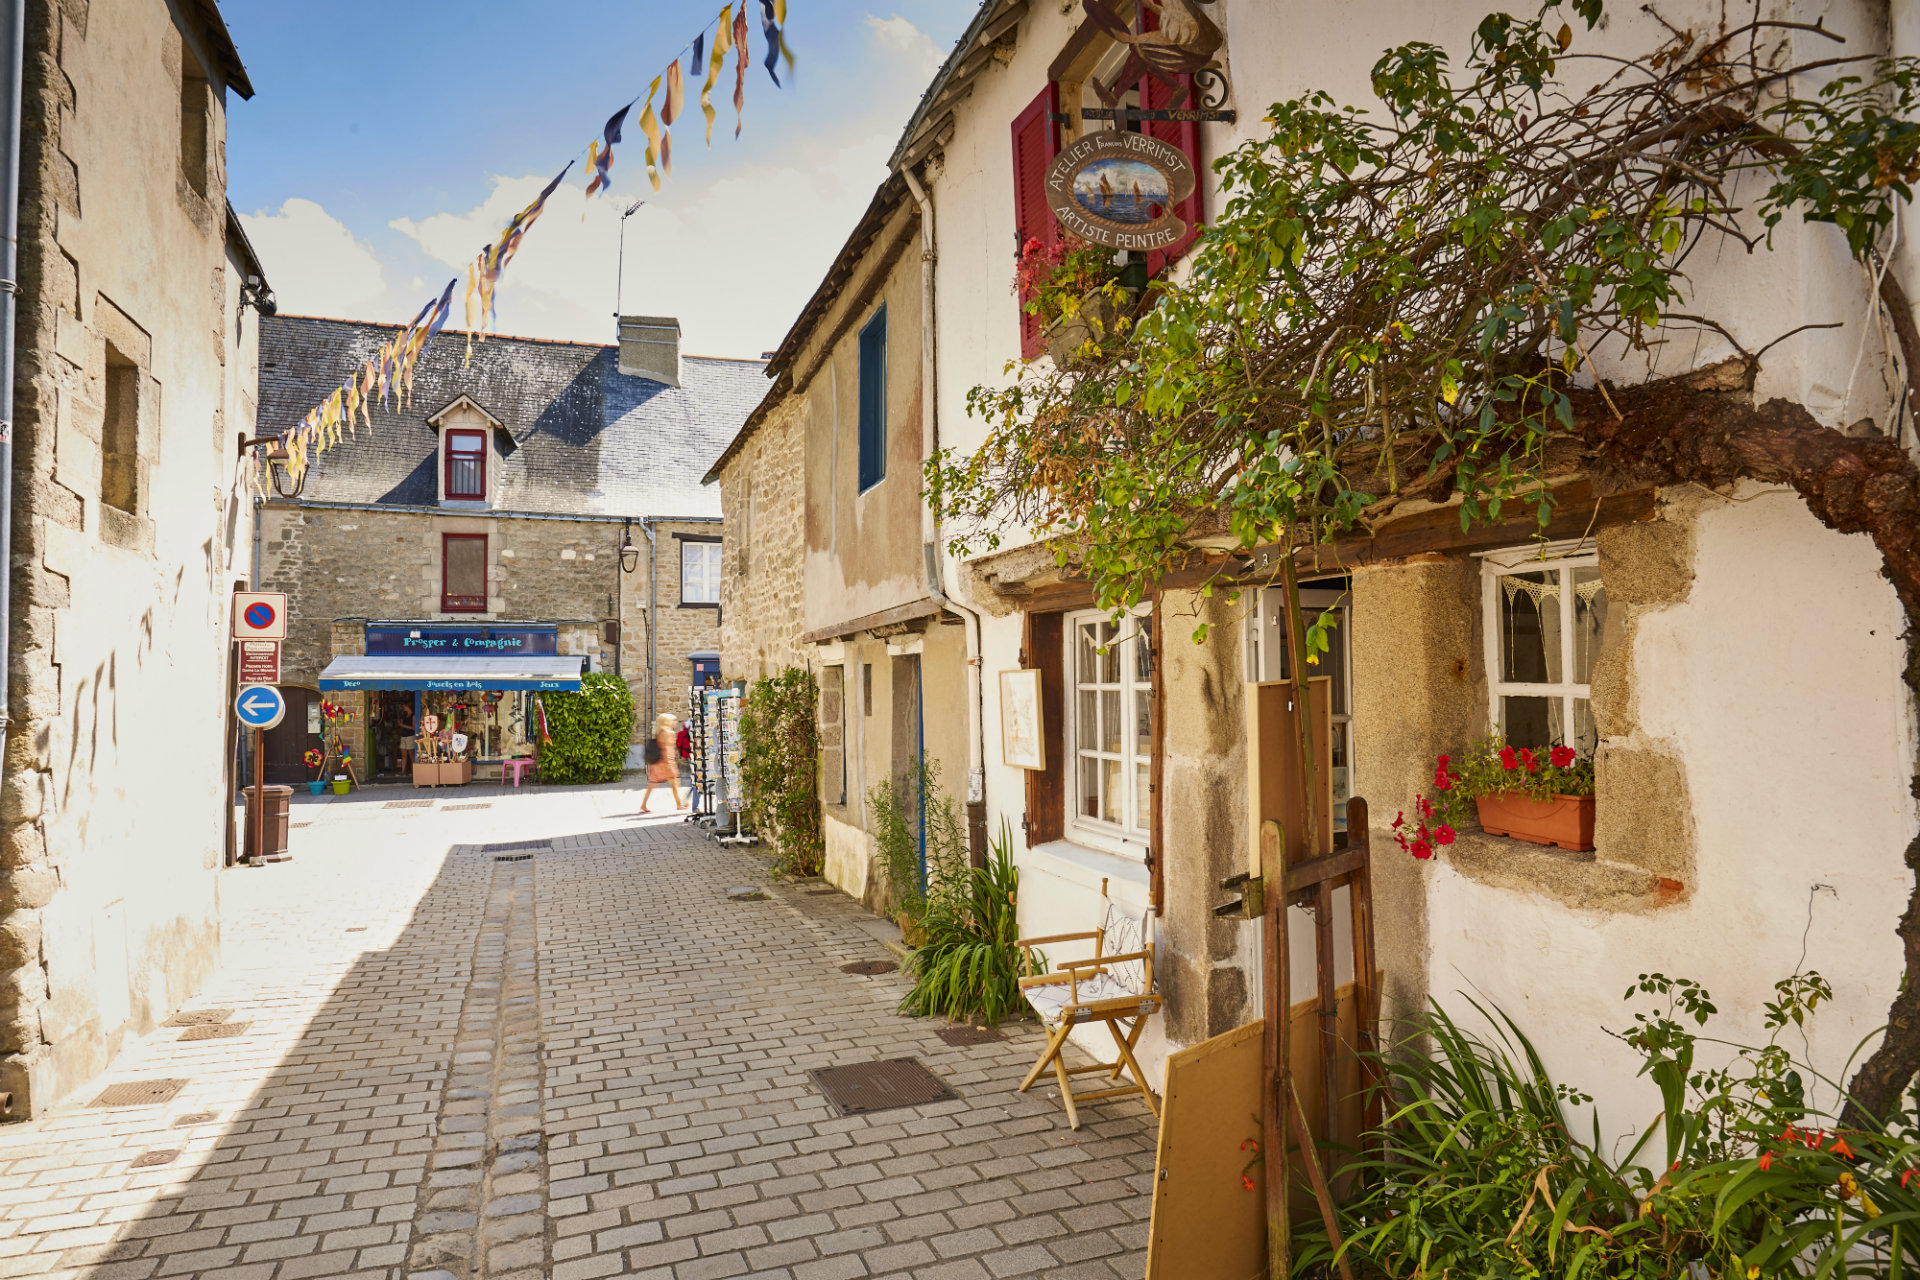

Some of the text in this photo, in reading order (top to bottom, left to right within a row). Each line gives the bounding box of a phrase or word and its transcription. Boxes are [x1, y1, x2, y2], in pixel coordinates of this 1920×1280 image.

[1050, 141, 1094, 191] ATELIER
[1123, 135, 1186, 172] VERRIMST
[1056, 206, 1176, 248] ARTISTE PEINTRE
[403, 637, 523, 650] Prosper & Compagnie
